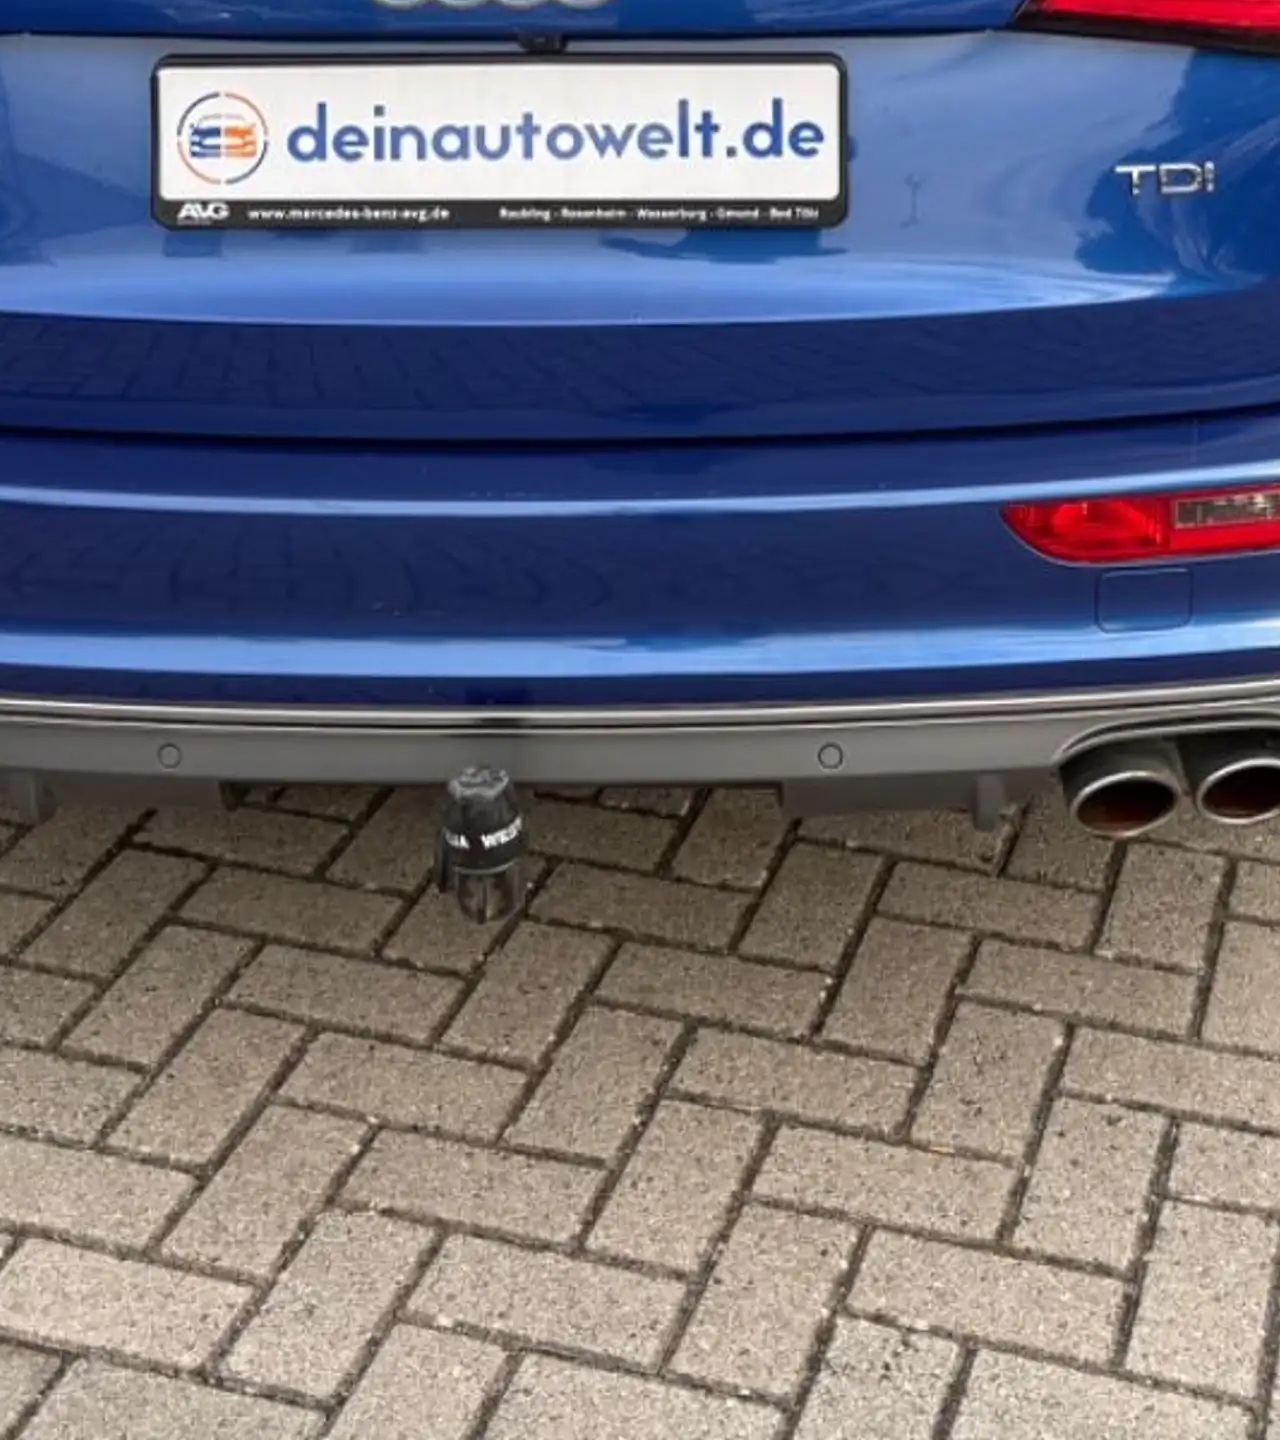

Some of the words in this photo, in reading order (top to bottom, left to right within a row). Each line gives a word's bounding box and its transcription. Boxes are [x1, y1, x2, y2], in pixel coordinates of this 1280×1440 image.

[286, 97, 825, 161] deinautowelt.de
[177, 203, 230, 220] AVG
[247, 206, 450, 223] www.mercedes-benz-avg.de
